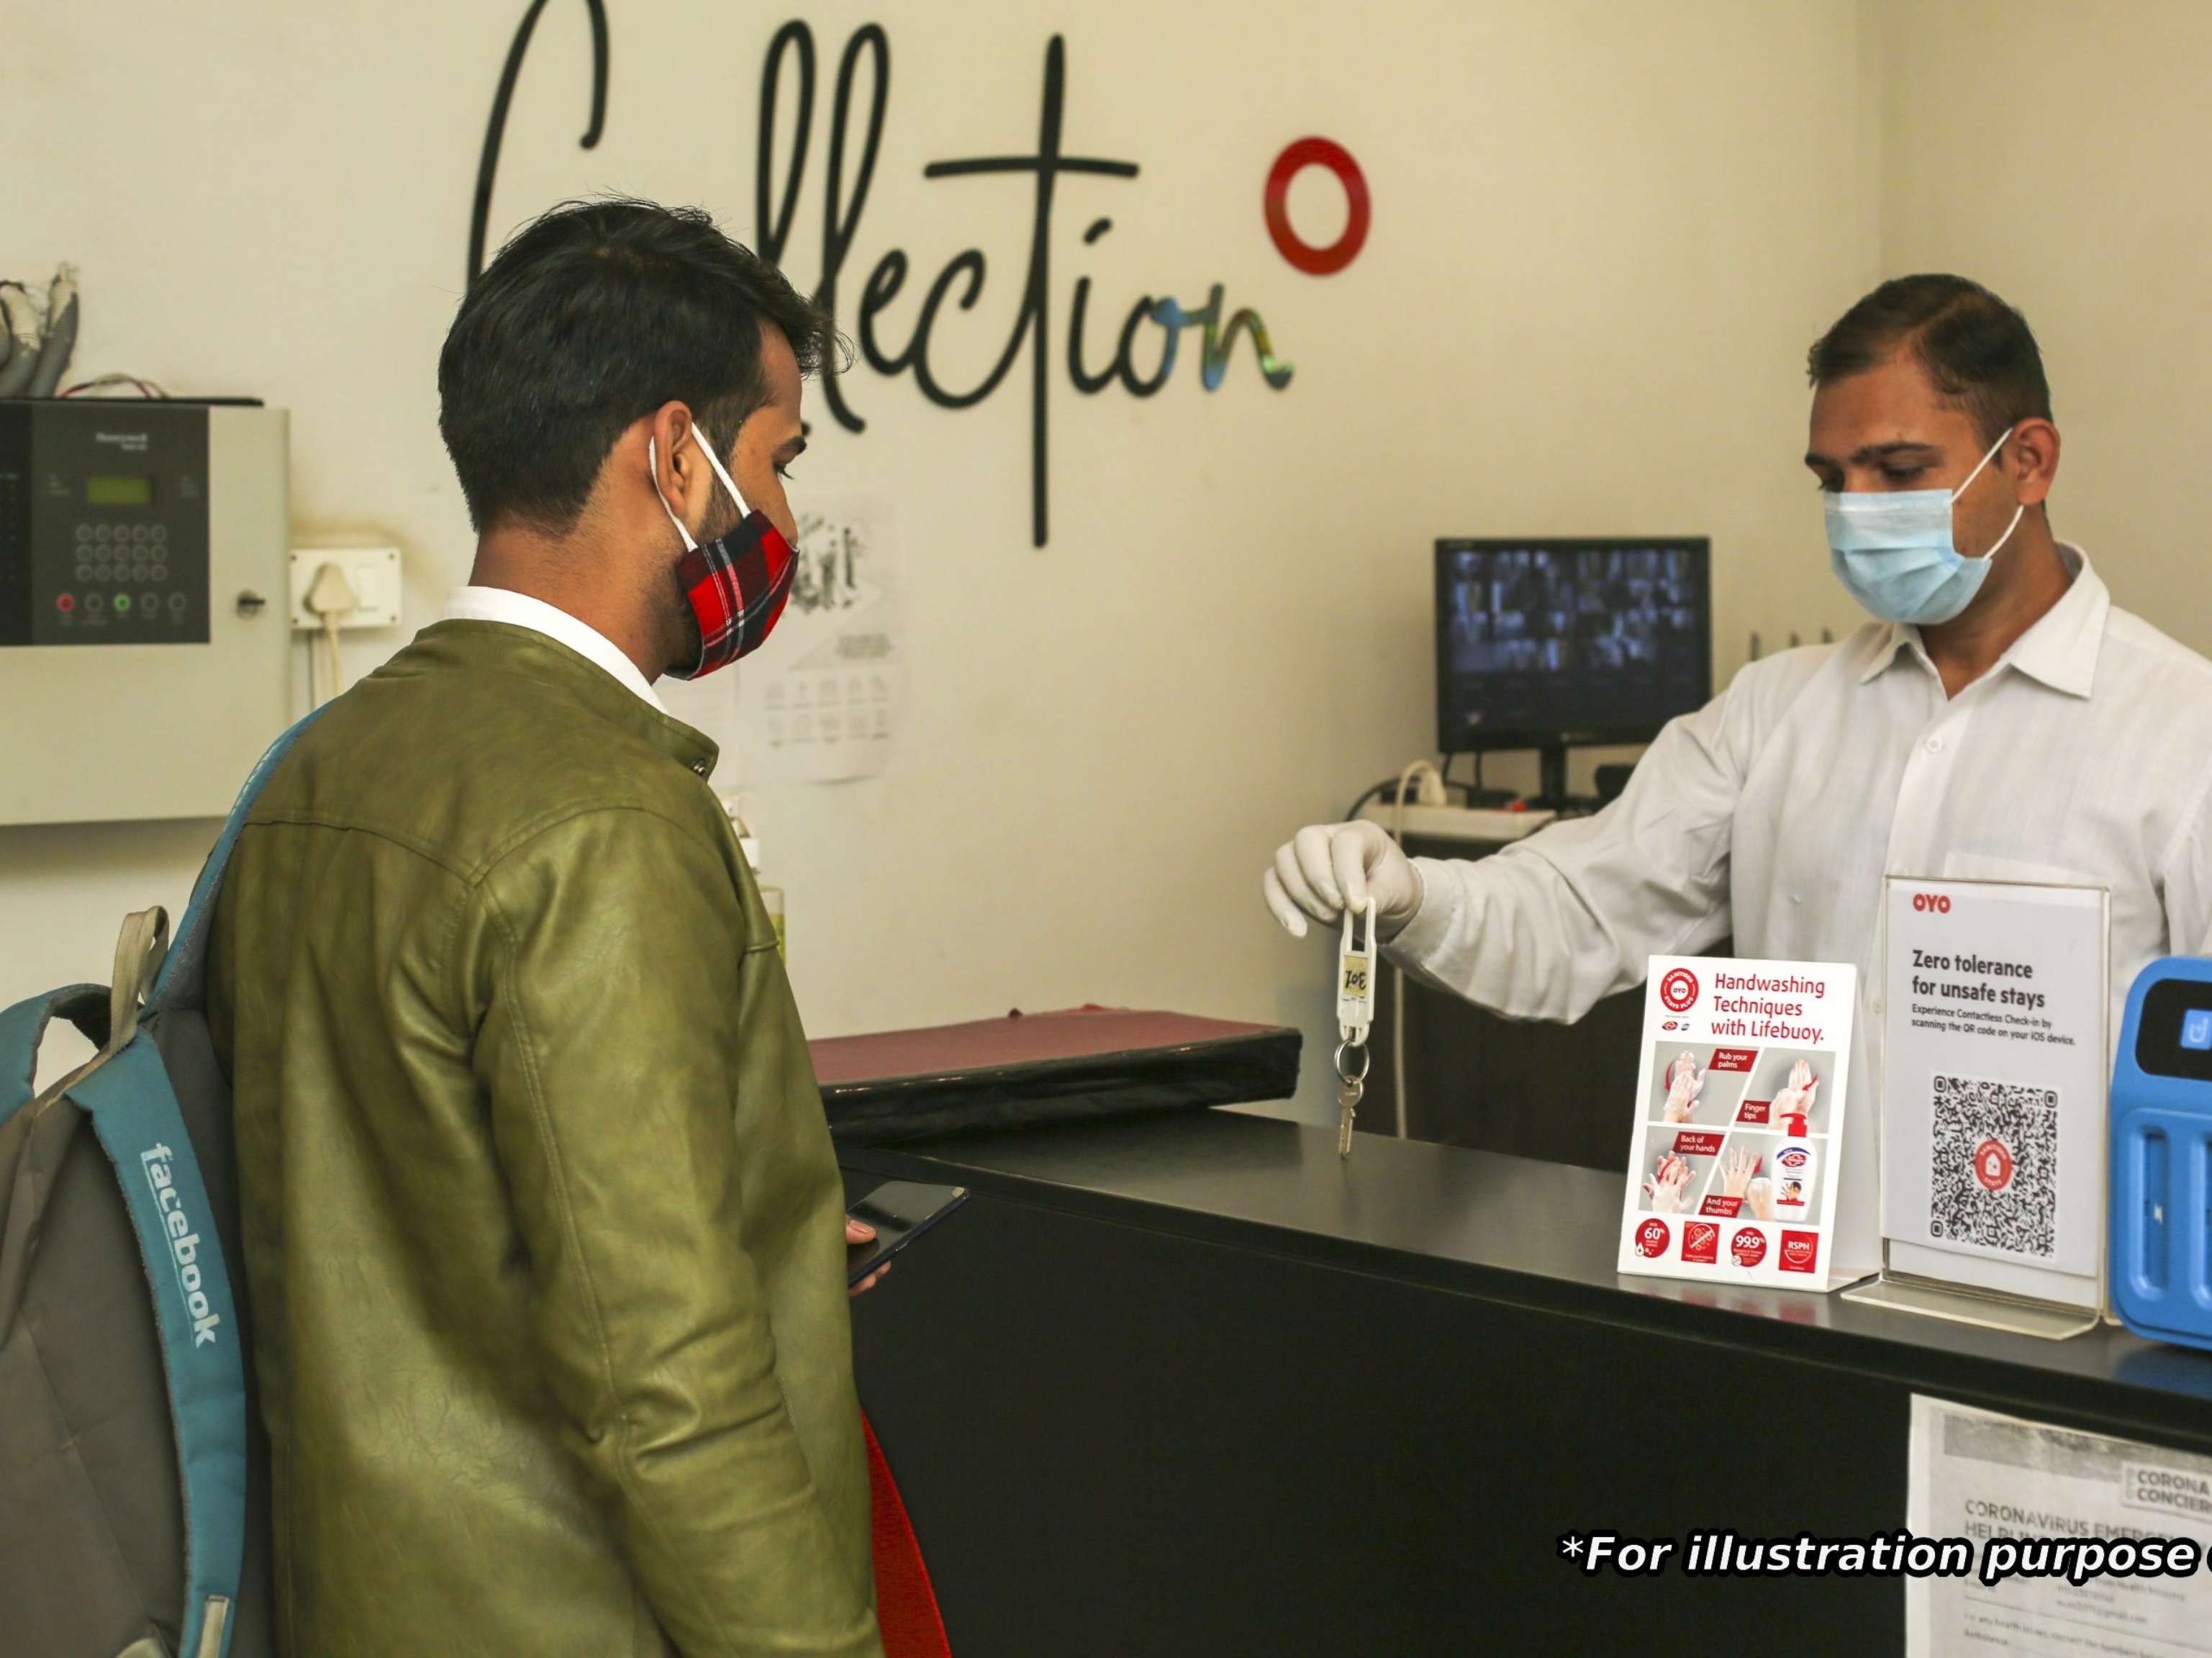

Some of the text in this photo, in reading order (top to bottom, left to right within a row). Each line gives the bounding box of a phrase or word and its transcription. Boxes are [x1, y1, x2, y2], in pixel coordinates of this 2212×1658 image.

[468, 0, 1295, 547] Cllection
[1913, 893, 1952, 914] OYO
[1912, 949, 2034, 979] Zero tolerance
[1715, 973, 1826, 999] Handwashing
[1912, 975, 2046, 1011] for unsafe stays
[1713, 996, 1803, 1019] Techniques
[1911, 1004, 2052, 1030] Experience Contactless Check-in by
[1711, 1018, 1746, 1036] with
[1751, 1020, 1824, 1045] Lifebuoy.
[1911, 1018, 1947, 1033] scanning
[1948, 1021, 1962, 1032] the
[1963, 1023, 1976, 1034] QR
[1977, 1025, 1996, 1037] code
[2010, 1031, 2029, 1041] your
[2046, 1033, 2077, 1046] device.
[1717, 1061, 1739, 1069] palms
[1718, 1052, 1749, 1062] Rub your
[1744, 1103, 1766, 1113] Finger
[1744, 1112, 1757, 1121] tips
[1695, 1144, 1715, 1153] hands
[1705, 1206, 1733, 1215] thumbs
[1706, 1197, 1739, 1208] And your
[141, 1143, 220, 1350] facebook
[1787, 1241, 1810, 1251] RSPH
[2137, 1469, 2210, 1496] CORONA
[1965, 1499, 2090, 1536] CORONAVIRUS
